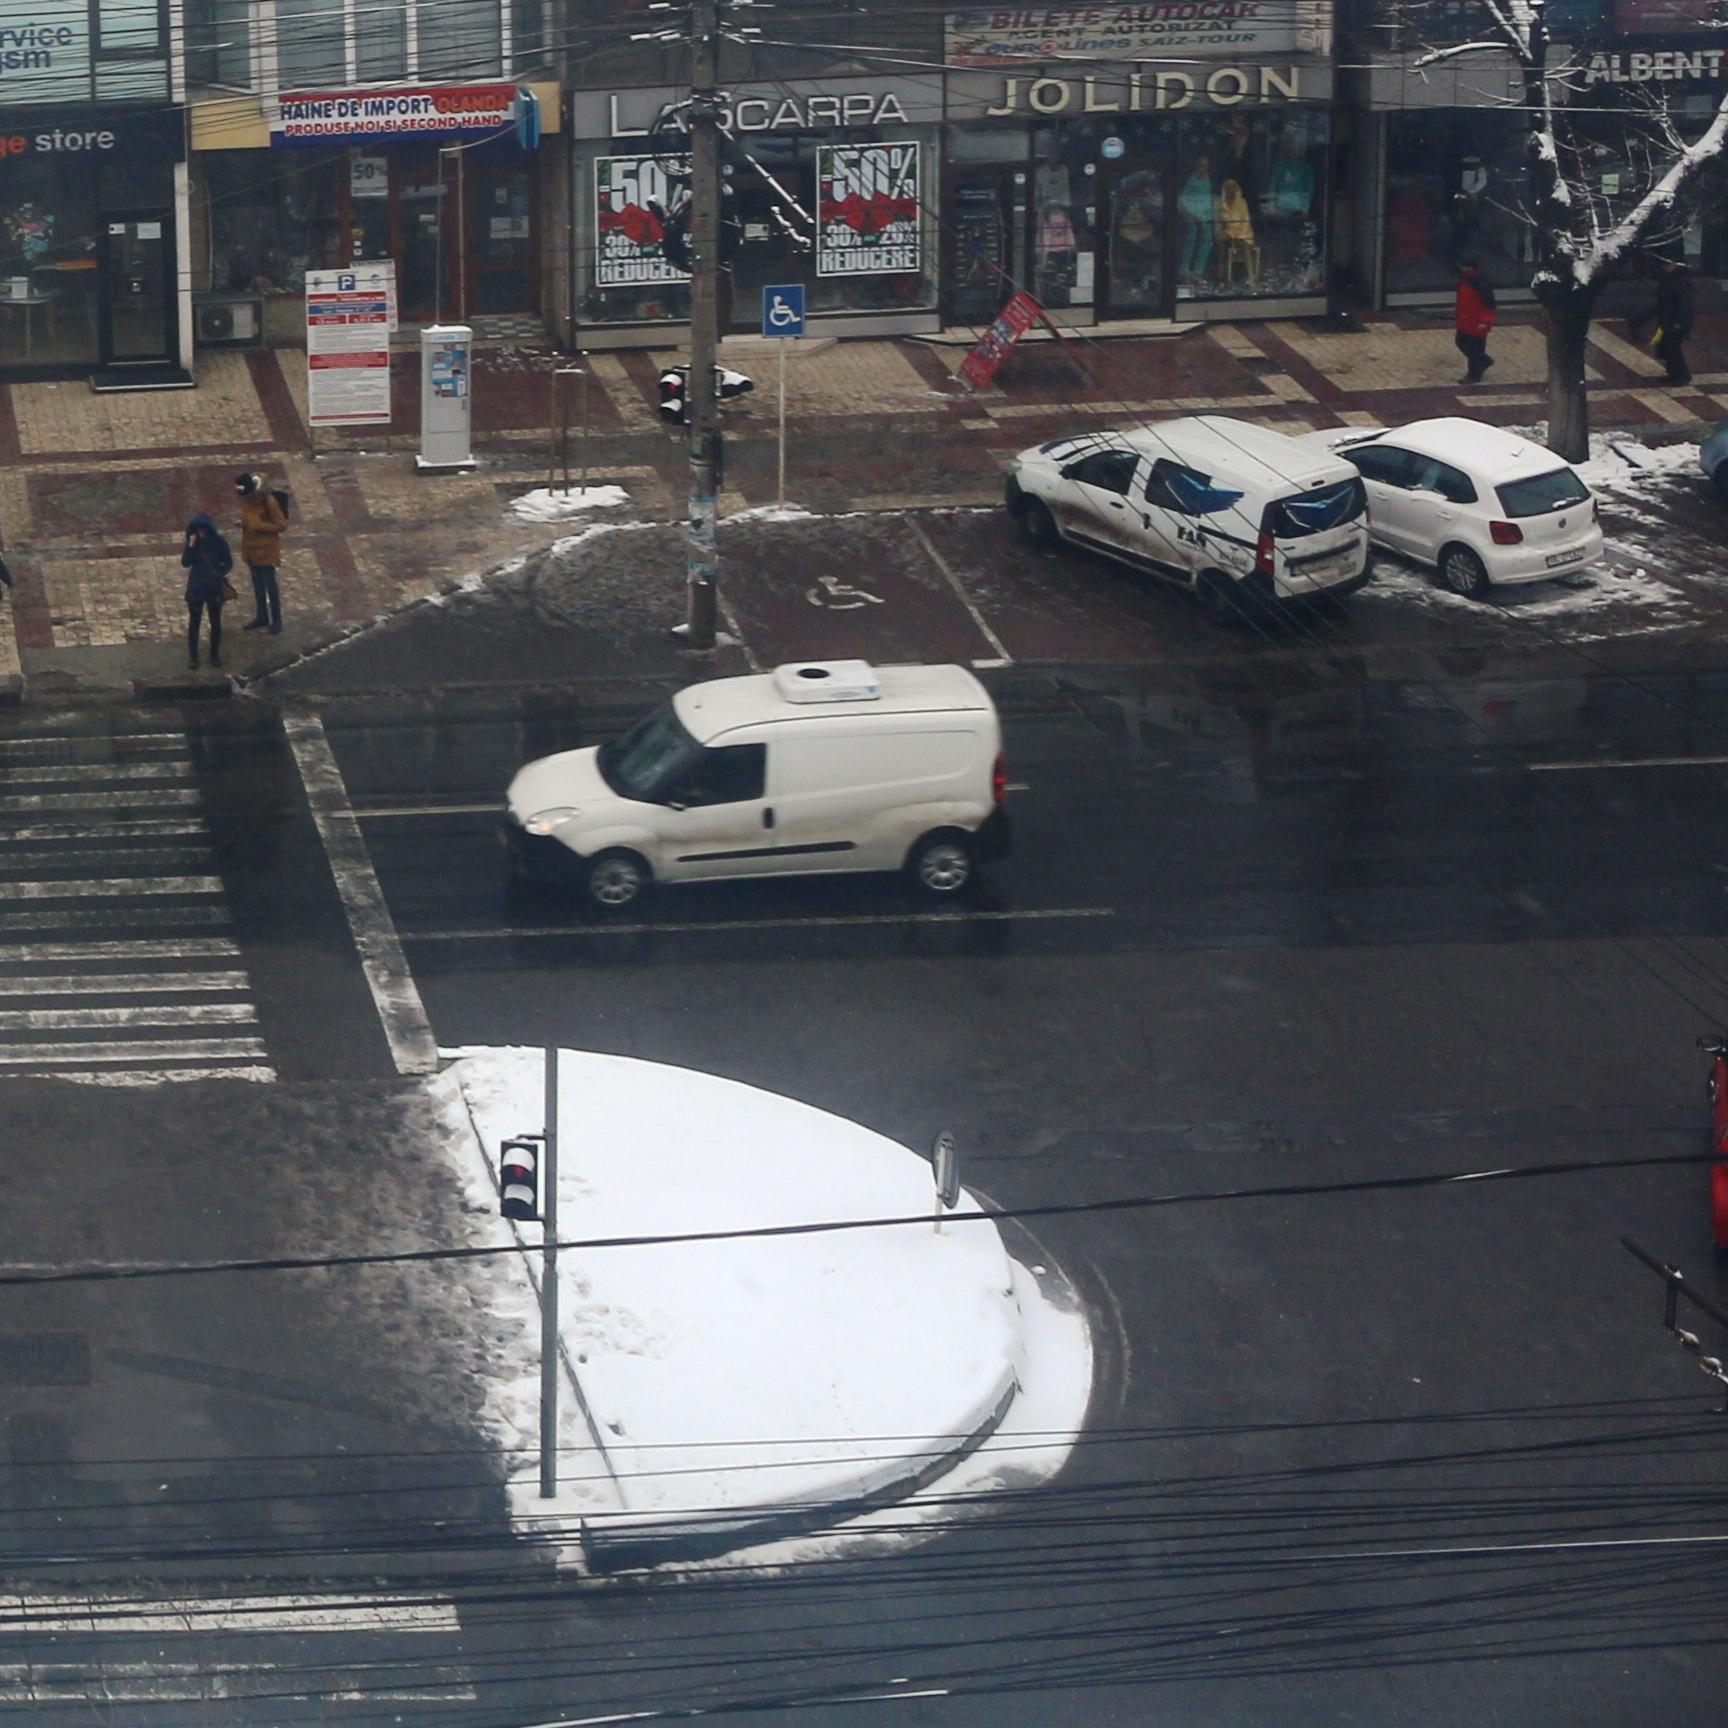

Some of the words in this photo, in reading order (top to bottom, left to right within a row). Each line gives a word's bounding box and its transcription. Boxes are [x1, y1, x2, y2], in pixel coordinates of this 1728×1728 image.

[1112, 2, 1261, 23] AUTOCAR
[1585, 49, 1725, 84] ALBENT
[987, 66, 1301, 116] JOLIDON
[281, 101, 332, 121] HAINE
[337, 100, 360, 118] DE
[364, 97, 431, 117] IMPORT
[435, 95, 509, 114] OLANDA
[285, 122, 350, 136] PRODUSE
[354, 120, 380, 132] NOI
[401, 117, 457, 130] SECOND
[461, 115, 502, 127] HAND
[35, 129, 115, 152] store
[833, 147, 915, 203] 50%
[821, 246, 915, 272] REDUCERE
